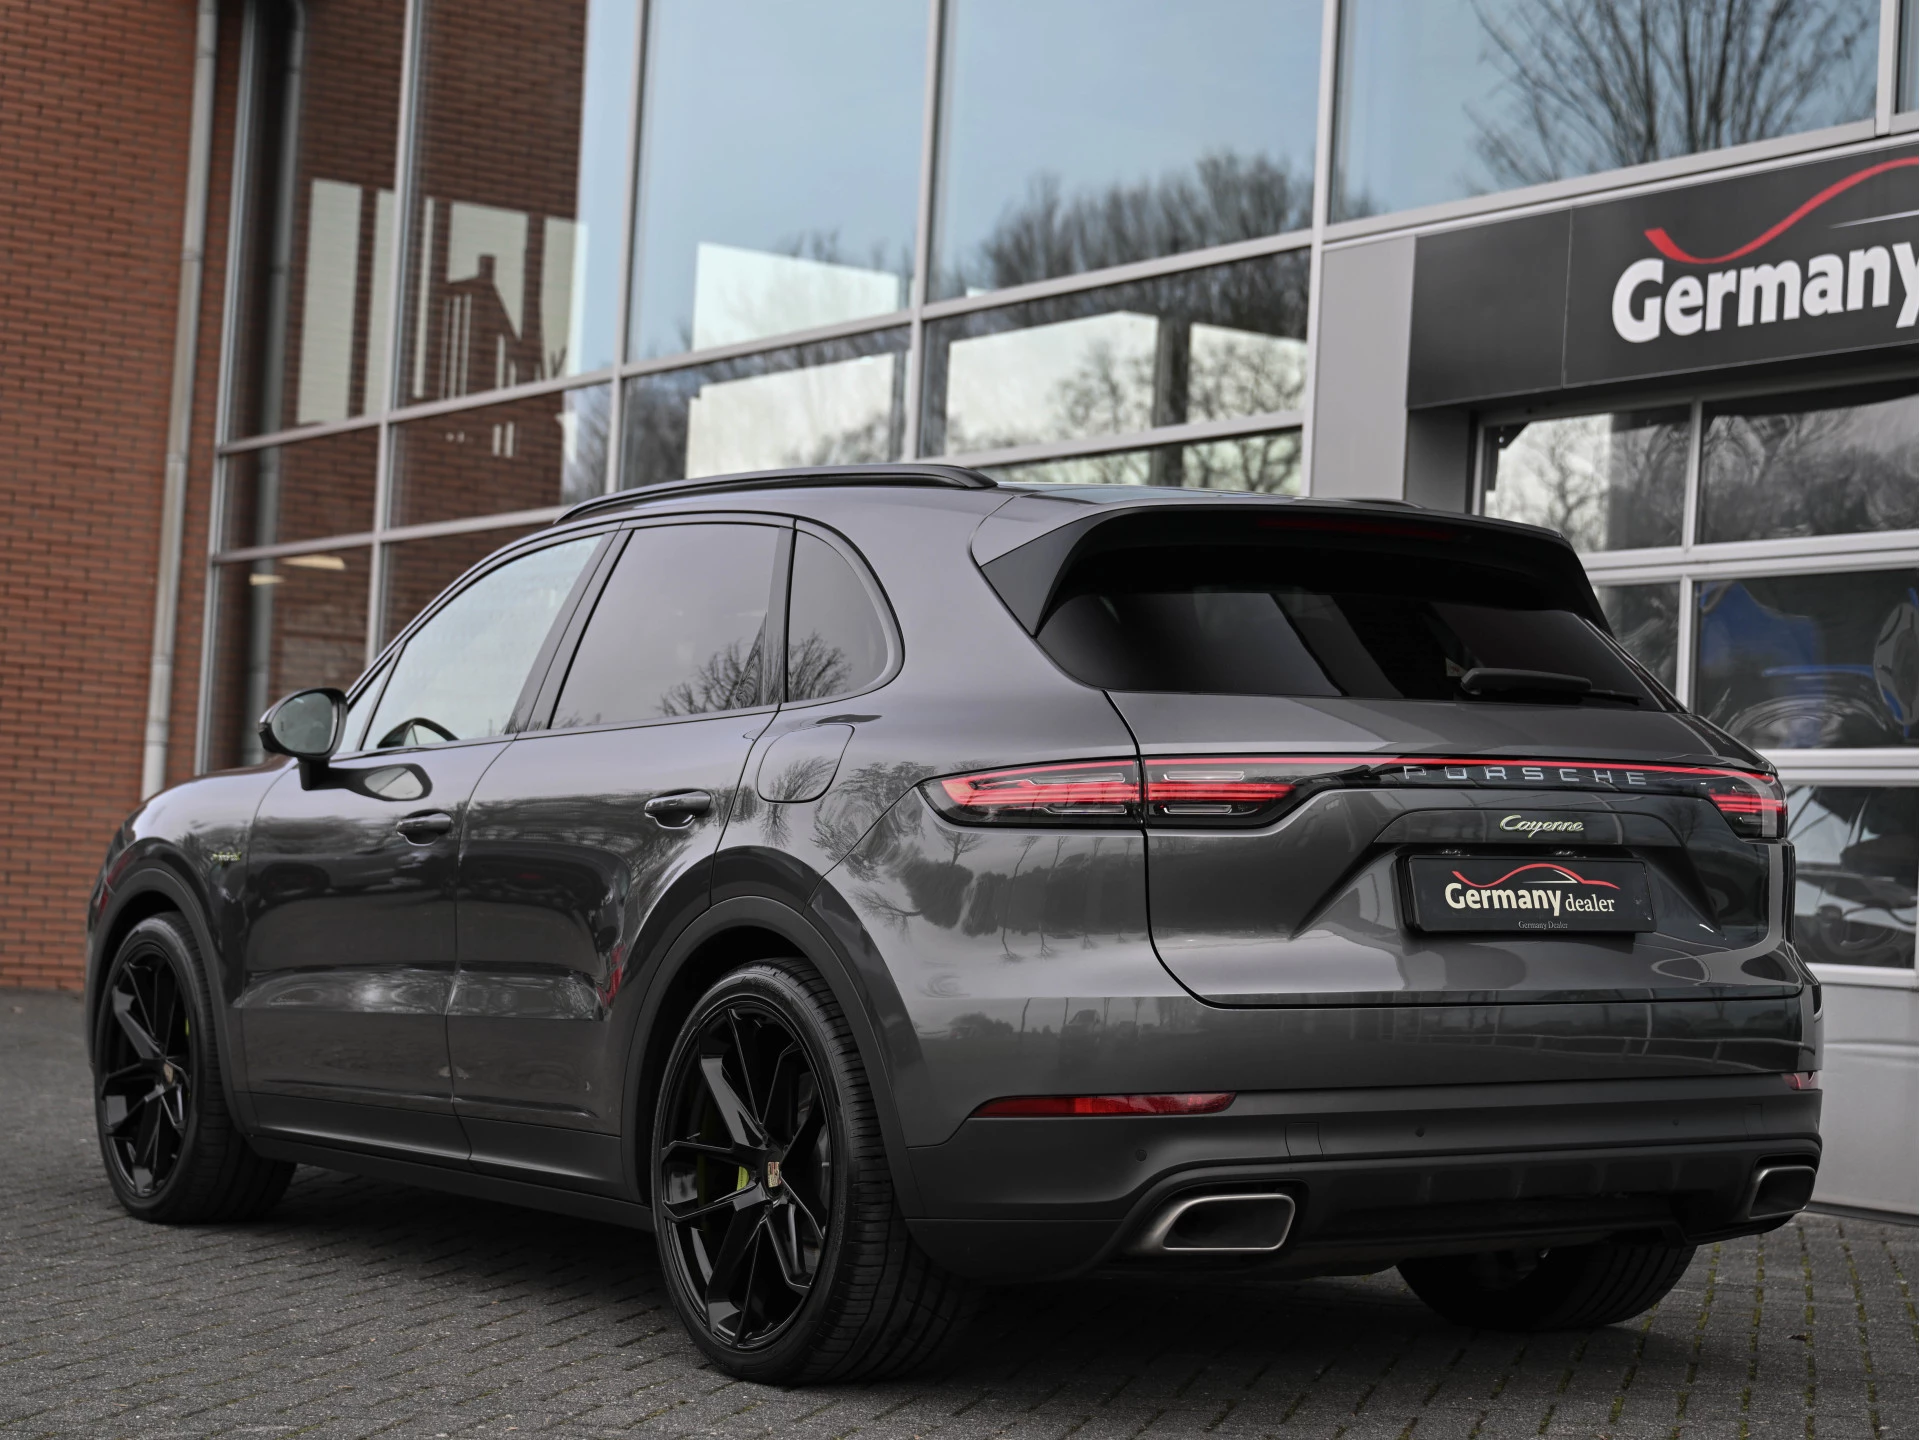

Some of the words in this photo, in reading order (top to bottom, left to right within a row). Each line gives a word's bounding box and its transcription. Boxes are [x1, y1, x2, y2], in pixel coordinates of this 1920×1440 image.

[1403, 765, 1647, 785] PORSCHE
[1500, 814, 1584, 838] Cayenne
[1445, 882, 1561, 917] Germany
[1565, 894, 1615, 912] dealer
[1518, 920, 1547, 930] Germany
[1548, 920, 1568, 929] Dealer
